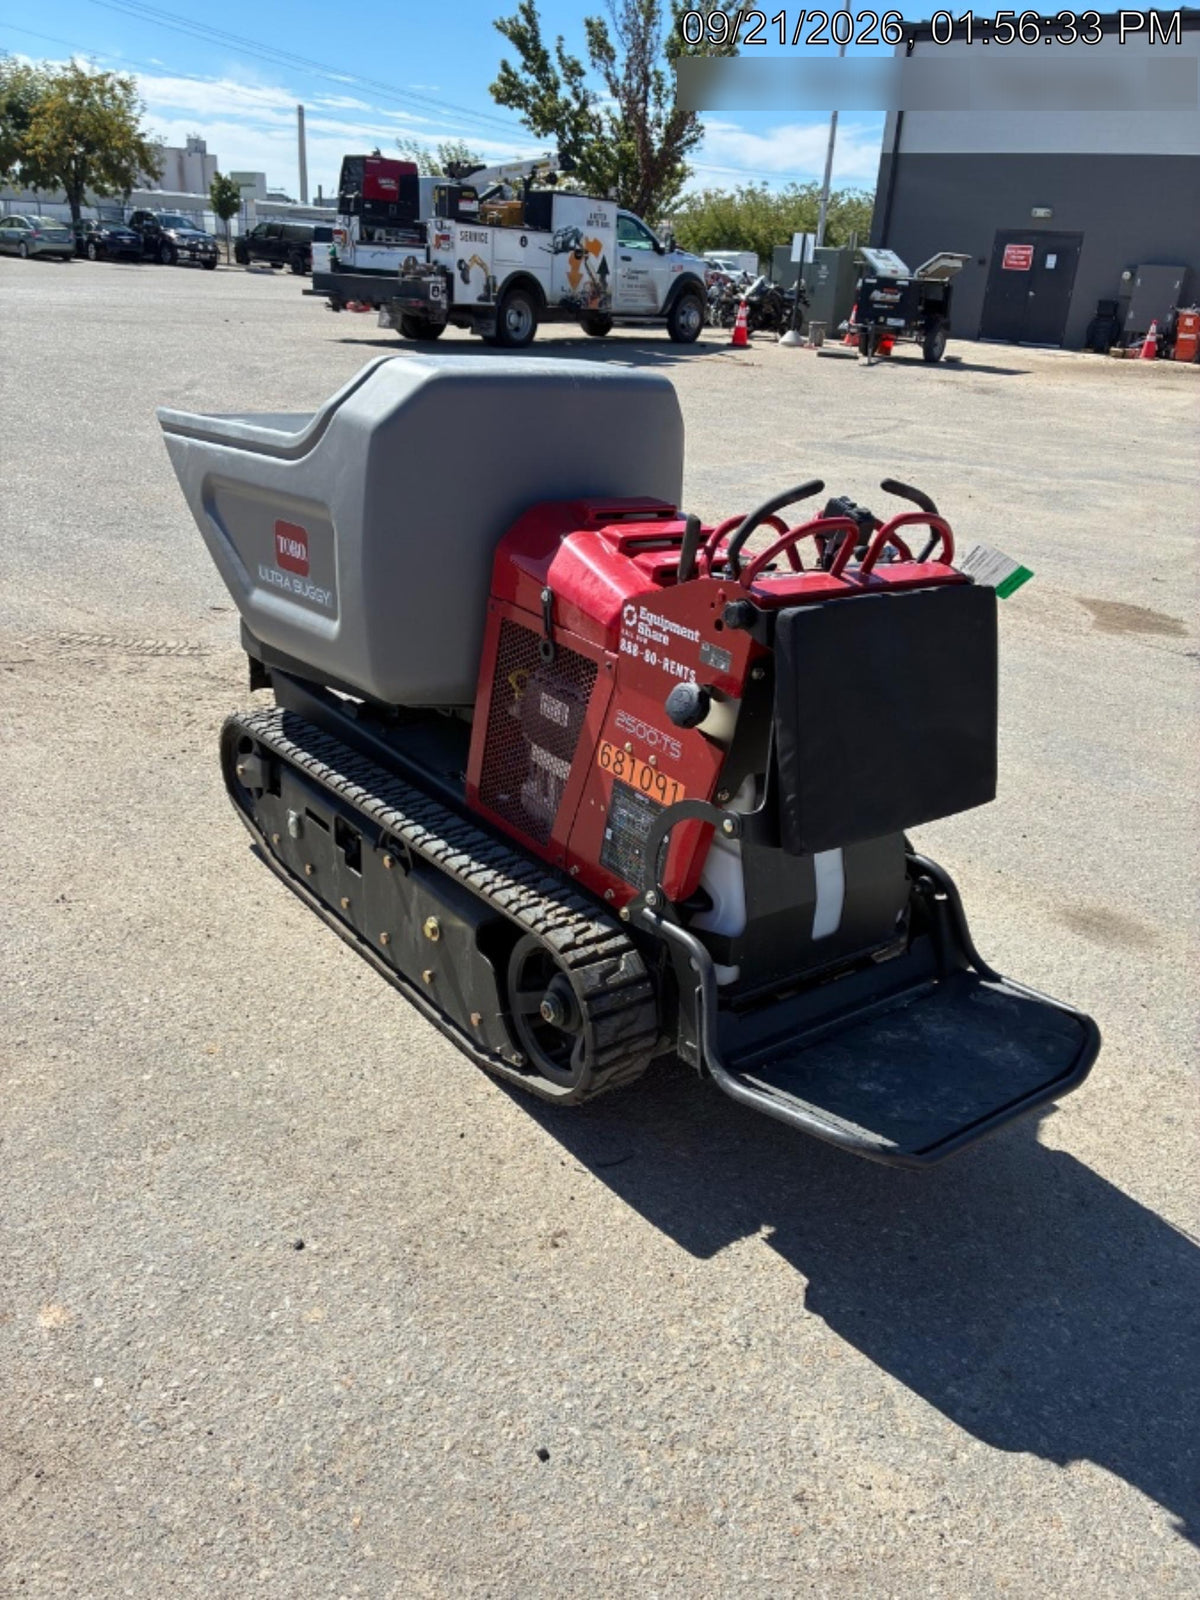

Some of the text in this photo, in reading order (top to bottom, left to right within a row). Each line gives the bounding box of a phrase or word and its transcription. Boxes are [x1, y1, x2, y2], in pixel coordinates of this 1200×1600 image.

[460, 230, 488, 244] SERVICE
[276, 534, 308, 561] TORO
[258, 563, 332, 605] ULTRA BUGGY
[637, 621, 669, 646] Share
[639, 605, 701, 643] Equipment
[619, 638, 697, 684] 888-80-RENTS
[600, 742, 679, 803] 681091
